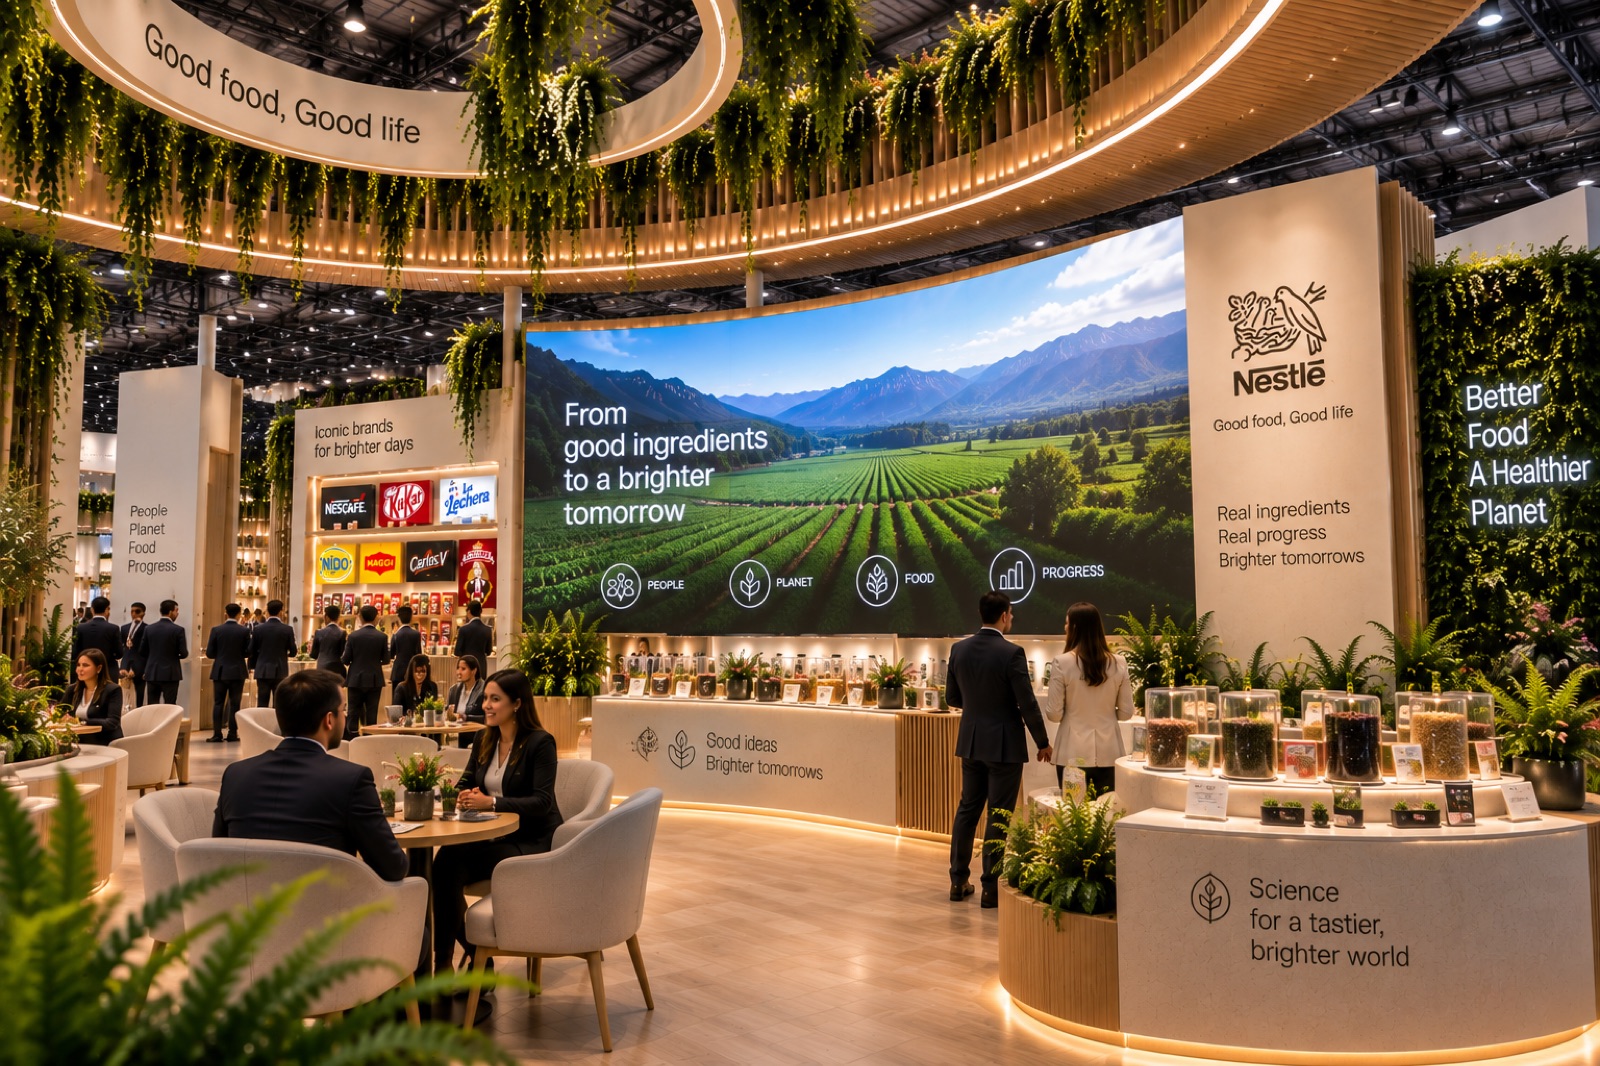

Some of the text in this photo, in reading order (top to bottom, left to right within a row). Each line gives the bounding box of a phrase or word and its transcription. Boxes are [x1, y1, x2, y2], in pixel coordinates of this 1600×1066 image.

[145, 23, 421, 144] Good food, Good life
[1466, 381, 1543, 412] Better
[565, 402, 627, 427] From
[1213, 404, 1354, 432] Good food, Good life
[314, 418, 393, 439] Iconic brands
[1468, 417, 1528, 450] Food
[314, 437, 414, 459] for brighter days
[564, 427, 768, 464] good ingredients
[563, 463, 715, 495] to a brighter
[1469, 454, 1592, 488] A Healthier
[130, 504, 168, 519] People
[563, 502, 686, 526] tomorrow
[1217, 499, 1351, 522] Real ingredients
[1471, 498, 1548, 526] Planet
[129, 522, 166, 535] Planet
[1218, 527, 1327, 546] Real progress
[128, 540, 156, 554] Food
[127, 559, 177, 576] Progress
[1042, 564, 1105, 579] PROGRESS
[1219, 550, 1365, 571] Brighter tomorrows
[647, 580, 685, 590] PEOPLE
[776, 576, 814, 588] PLANET
[904, 573, 935, 584] FOOD
[744, 734, 778, 753] ideas
[706, 755, 824, 781] Brighter tomorrows
[1249, 877, 1339, 903] Science
[1250, 907, 1385, 939] for a tastier,
[1251, 938, 1409, 968] brighter world
